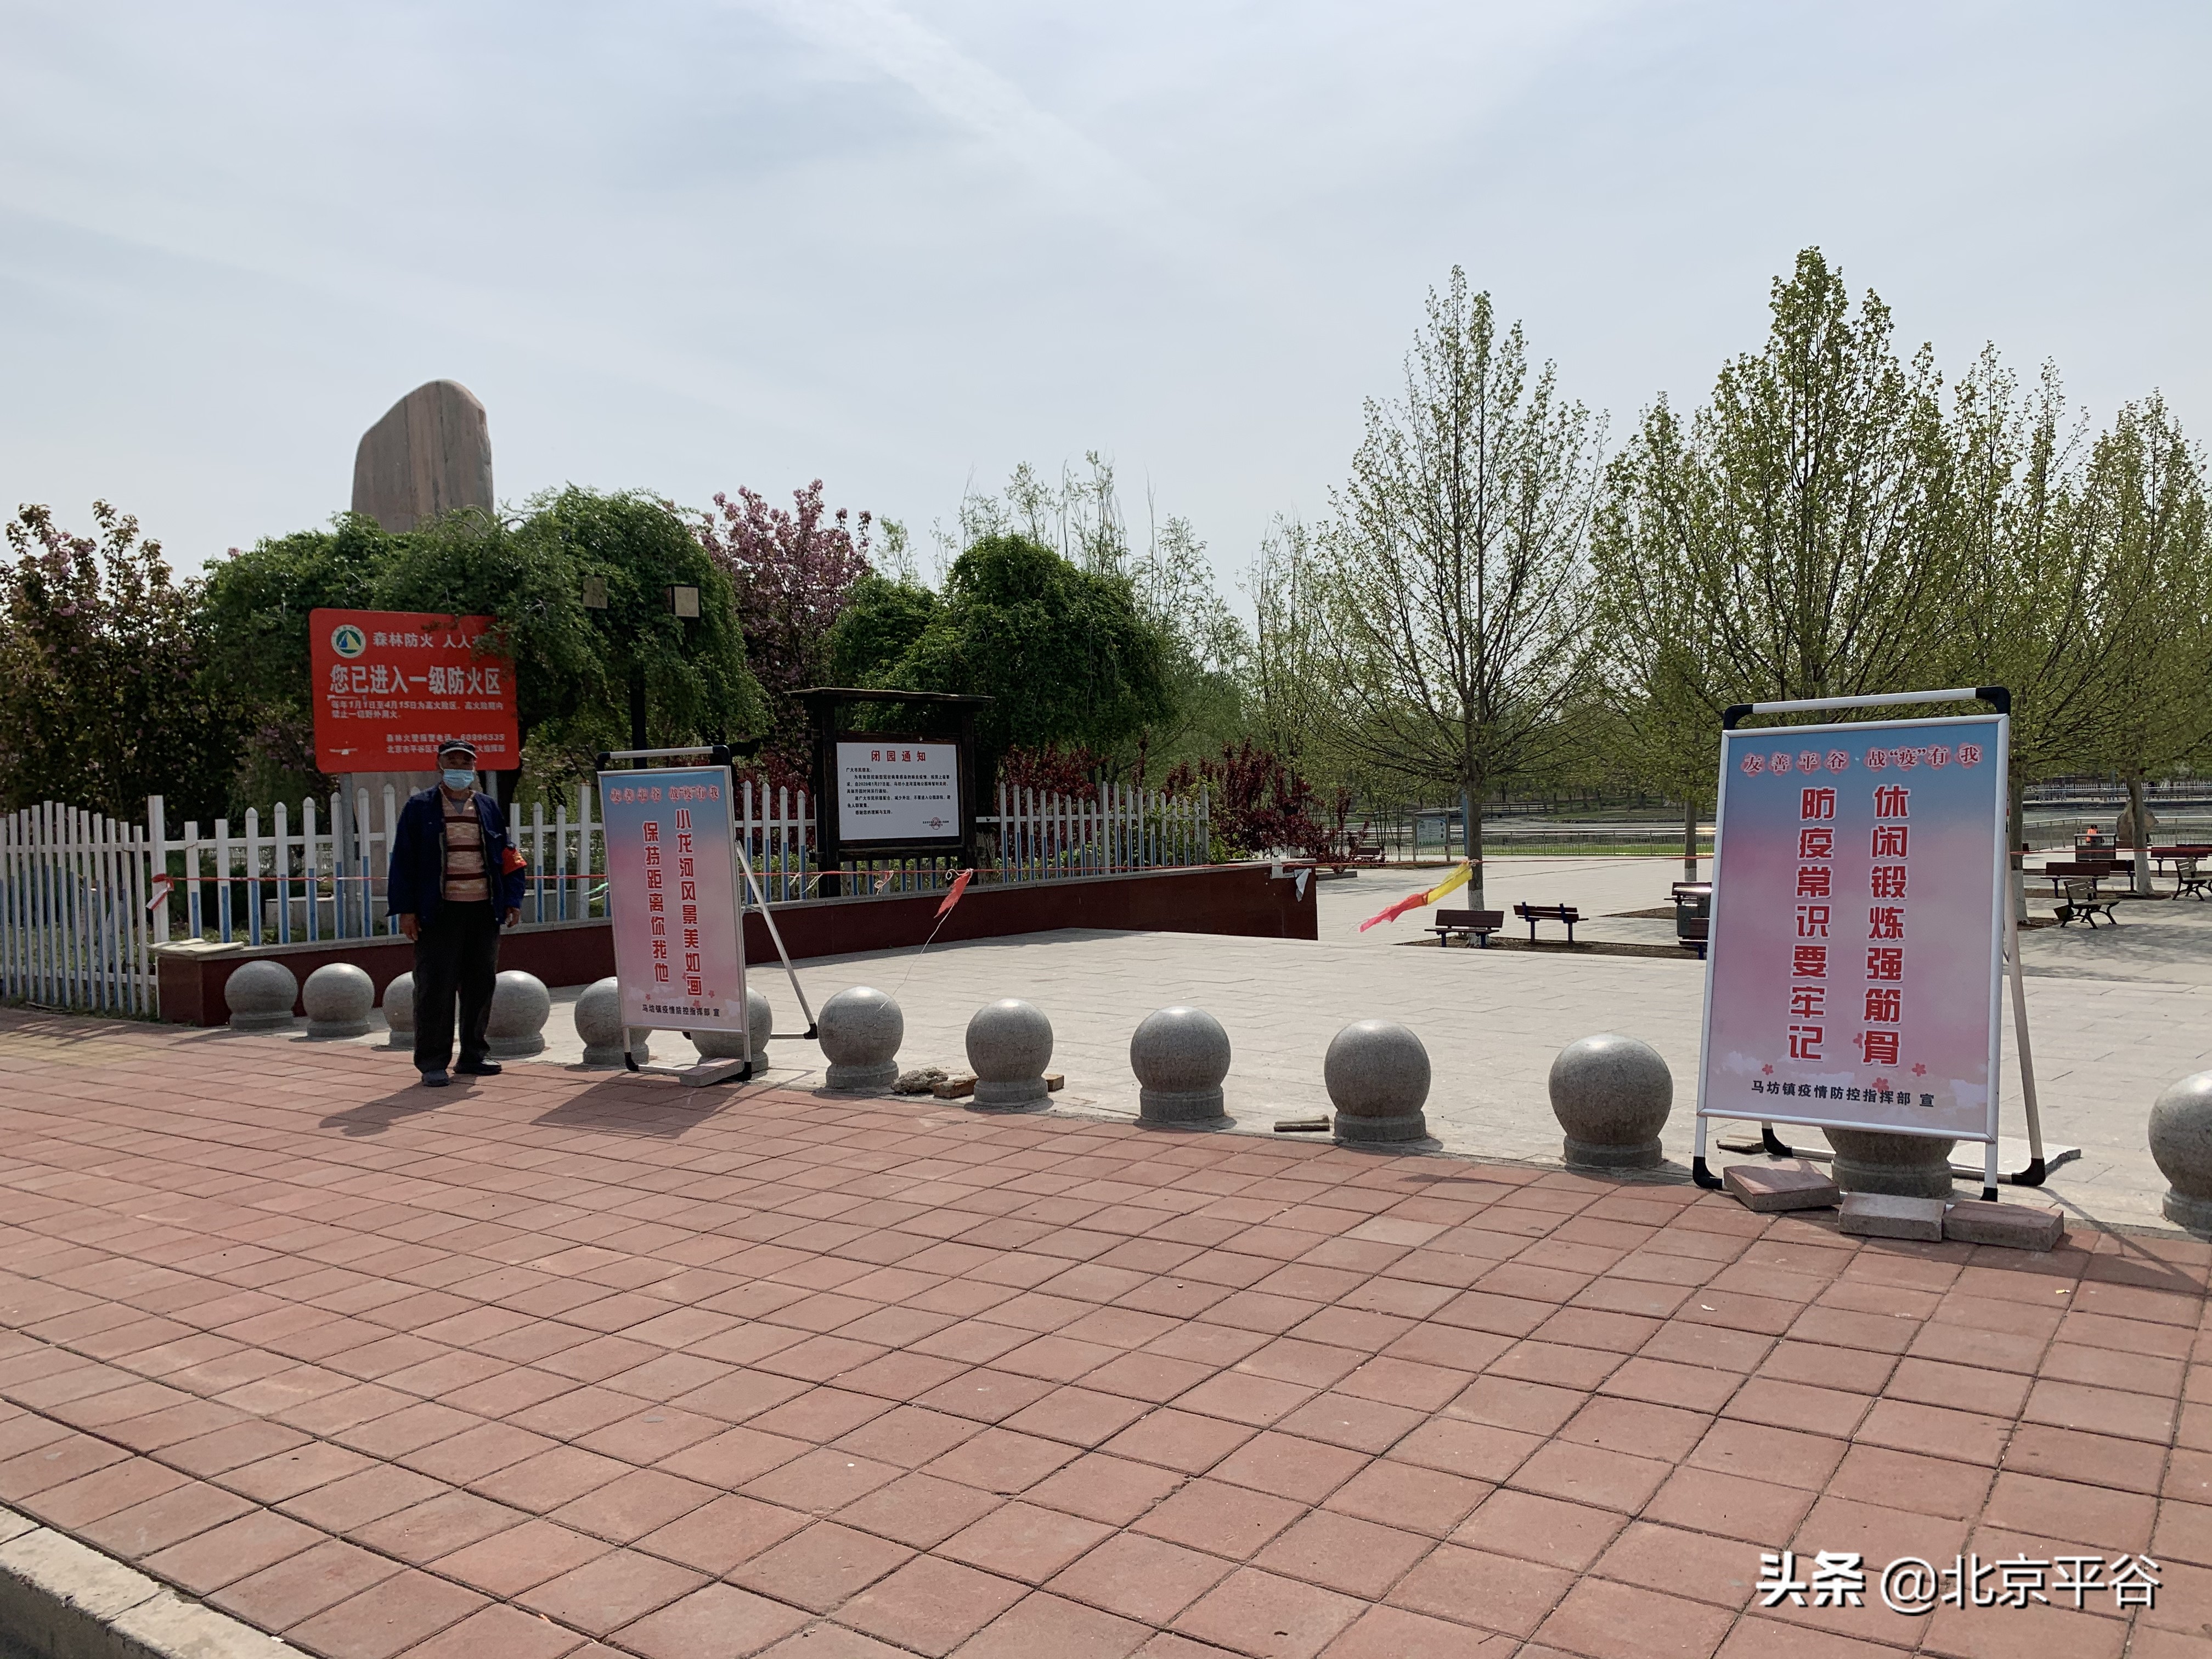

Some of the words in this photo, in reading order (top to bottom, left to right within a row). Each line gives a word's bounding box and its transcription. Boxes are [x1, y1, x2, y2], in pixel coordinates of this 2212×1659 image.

[373, 631, 433, 648] 森林防火
[330, 663, 502, 696] 您已进入一级防火区
[871, 750, 926, 762] 闭园通知
[1744, 752, 1847, 772] 友善平谷
[1867, 746, 1980, 767] 战“疫”有我
[642, 821, 669, 983] 保持距离你我他
[676, 808, 702, 997] 小龙河风景美如画
[1787, 787, 1837, 1062] 防疫常识要牢记
[1862, 785, 1911, 1066] 休闲锻炼强筋骨
[642, 1004, 710, 1017] 马坊镇疫情防控指挥部
[1751, 1080, 1911, 1106] 马坊镇疫情防控指挥部
[1919, 1093, 1934, 1108] 宣
